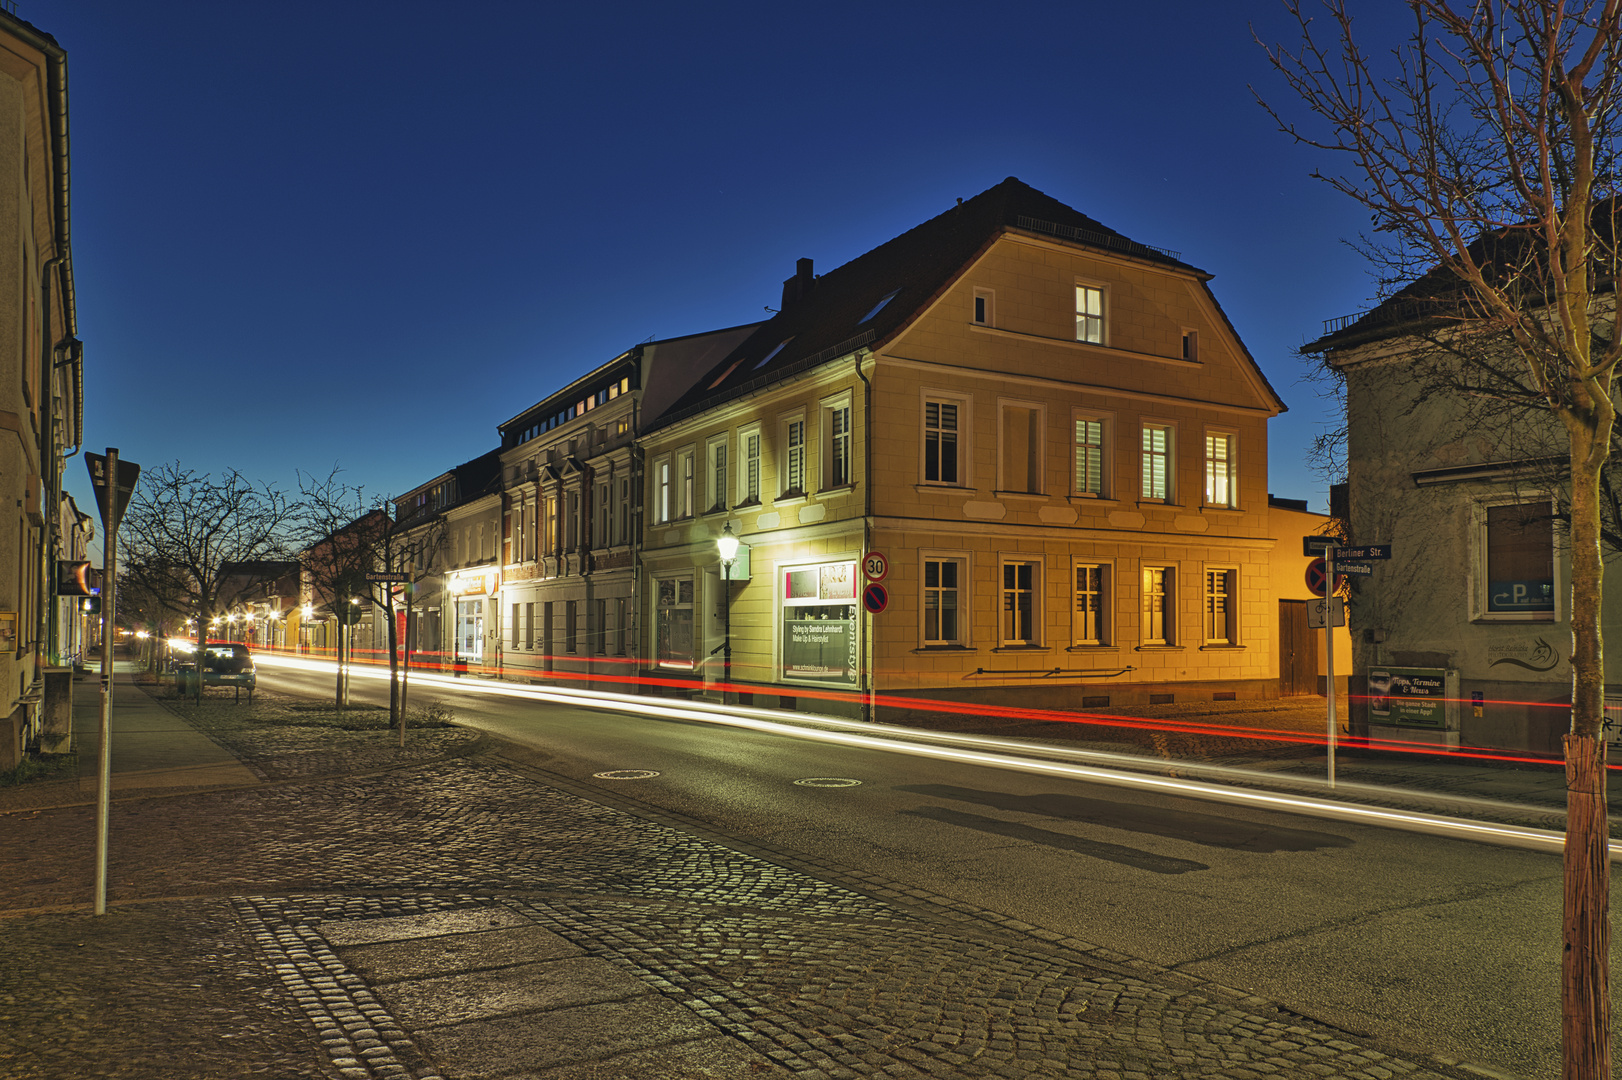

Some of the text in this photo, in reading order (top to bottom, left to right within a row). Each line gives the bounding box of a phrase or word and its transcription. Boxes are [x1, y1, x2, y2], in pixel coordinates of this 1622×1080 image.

[1336, 547, 1383, 558] Berliner Str.
[867, 560, 883, 574] 30
[1336, 562, 1371, 574] Gartenstraße
[365, 573, 404, 581] Gartenstraße
[1513, 584, 1527, 604] P
[809, 624, 823, 633] Sandra
[847, 605, 857, 682] Eventstyle
[1392, 677, 1440, 686] Tipps, Termine
[1410, 686, 1429, 694] News
[1405, 701, 1421, 709] ganze
[1421, 700, 1437, 709] Stadt
